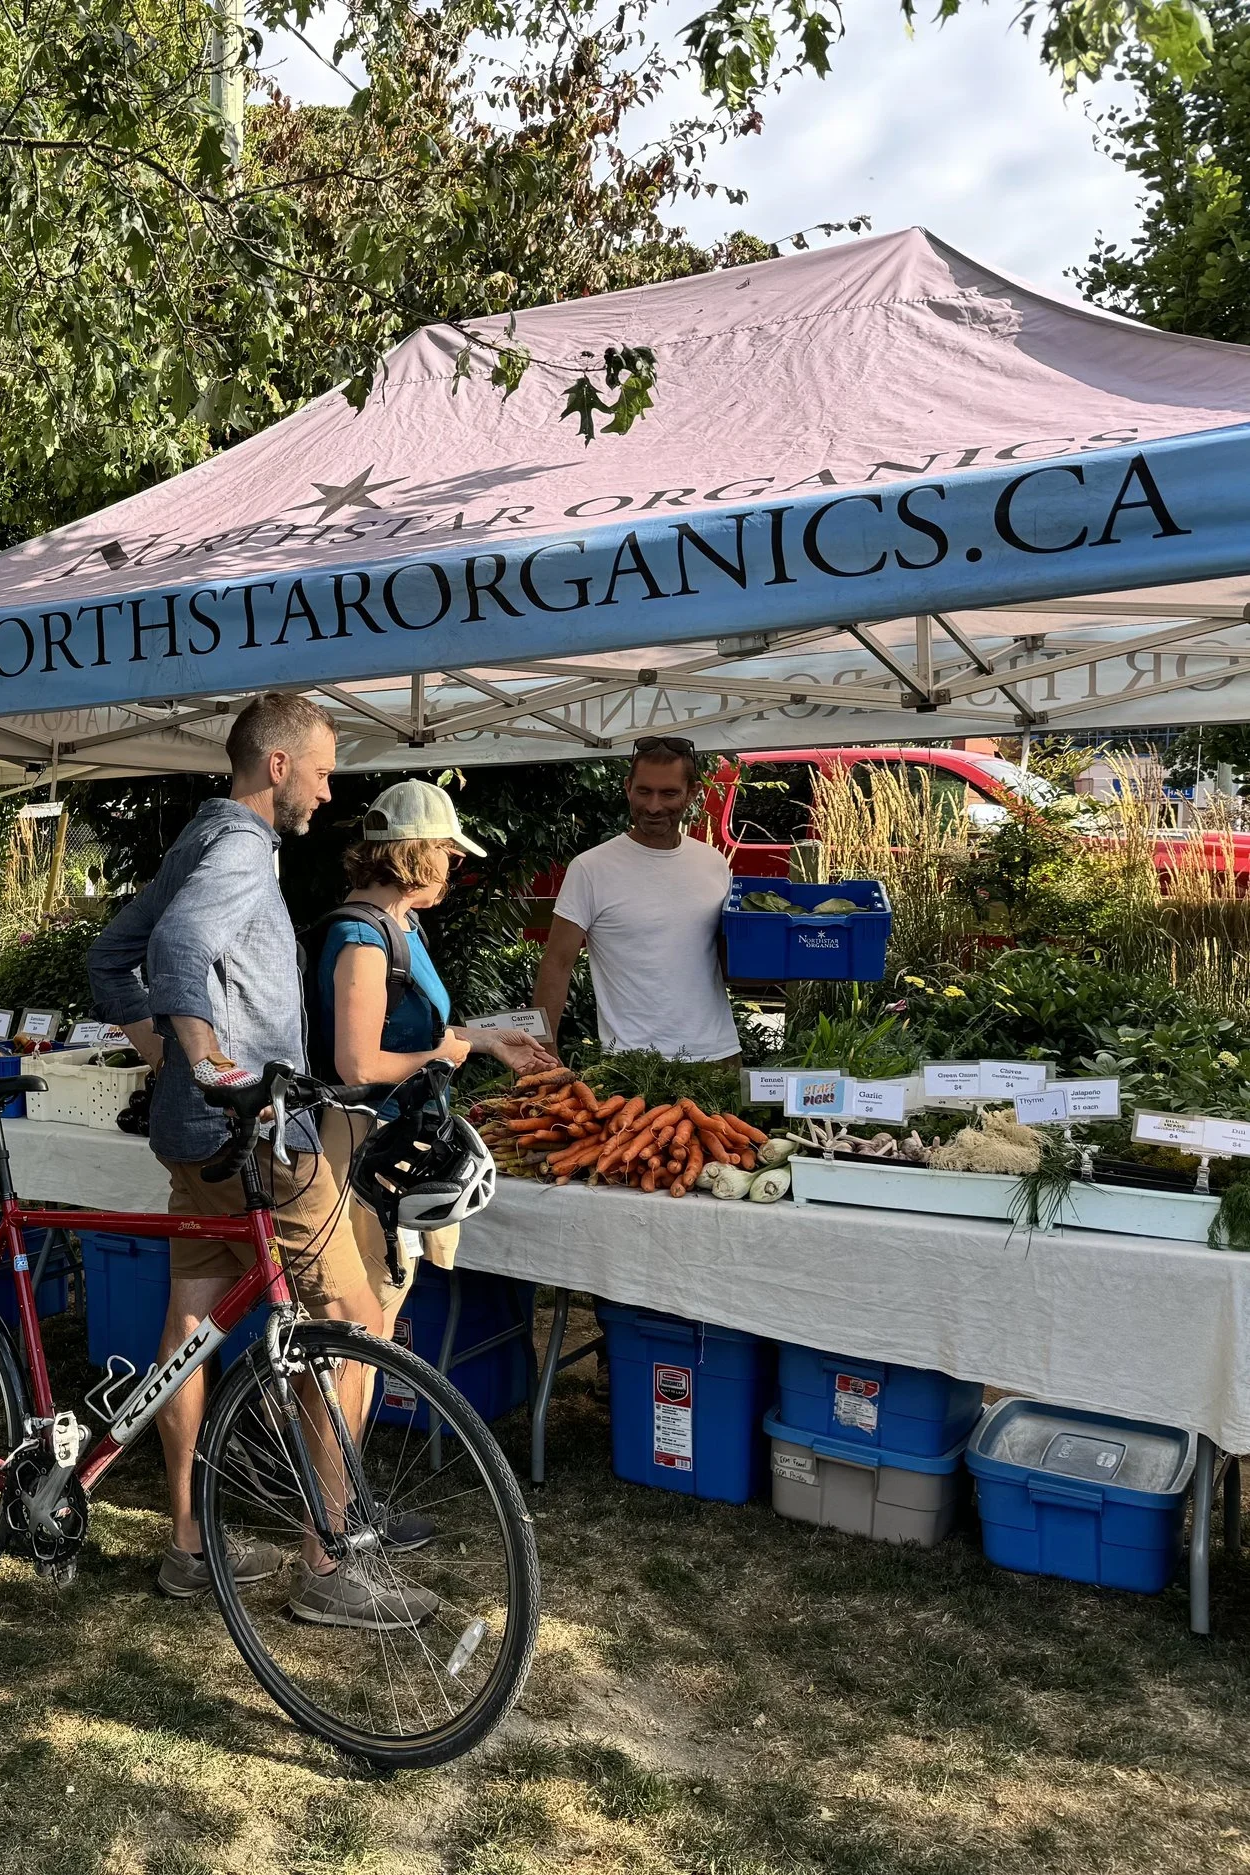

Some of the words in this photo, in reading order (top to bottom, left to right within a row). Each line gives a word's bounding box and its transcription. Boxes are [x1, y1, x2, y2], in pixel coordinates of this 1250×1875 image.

[44, 505, 535, 582] NORTHSTAR
[562, 426, 1141, 518] ORGANICS
[798, 934, 839, 944] NORTHSTAR
[804, 1081, 837, 1094] STAFF
[803, 1093, 835, 1106] PICK!
[859, 1091, 883, 1100] Garlic
[1019, 1096, 1044, 1105] Thyme
[1051, 1107, 1058, 1116] 4
